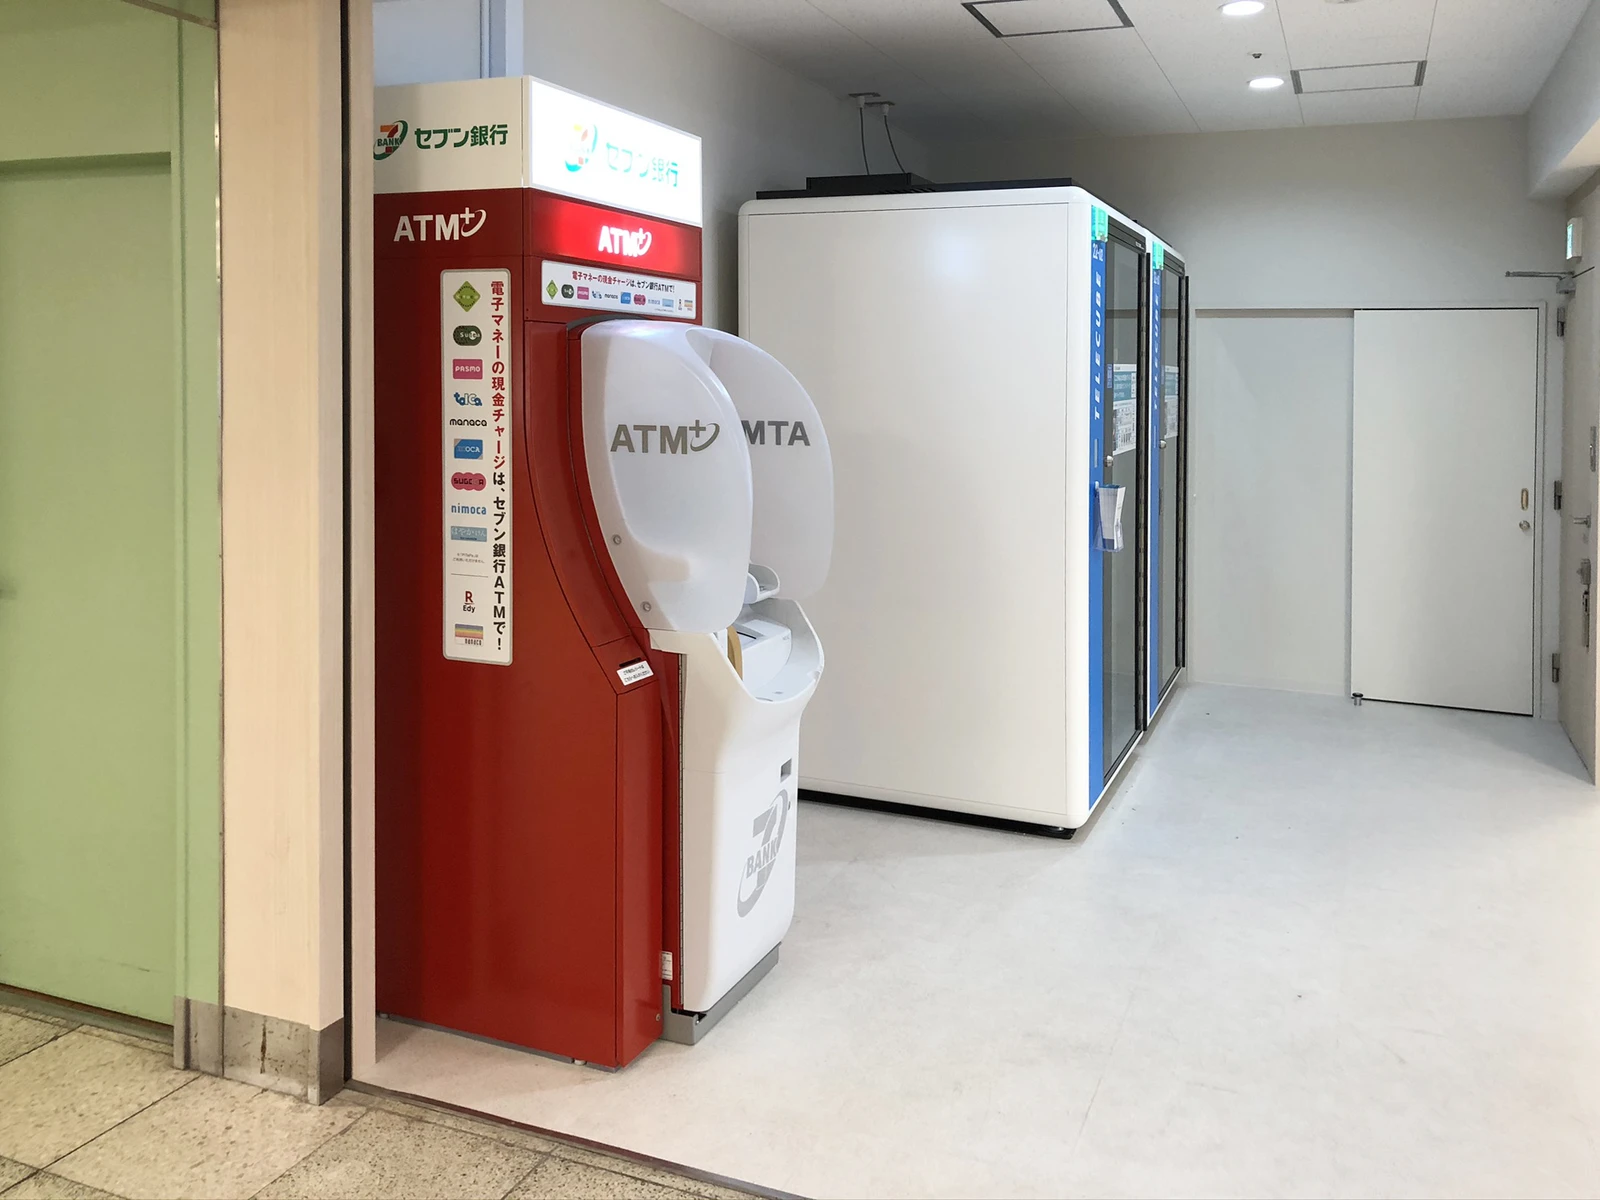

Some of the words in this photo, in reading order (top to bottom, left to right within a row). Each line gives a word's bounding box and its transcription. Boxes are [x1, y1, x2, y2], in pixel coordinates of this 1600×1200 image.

[377, 137, 401, 147] BANK
[414, 123, 509, 150] セブン銀行
[606, 142, 679, 188] セブン銀行
[1093, 271, 1102, 421] TELECUBE
[455, 365, 480, 373] PASMO
[449, 418, 487, 427] manaca
[491, 281, 506, 650] 電子マネーの現金チャージは、セブン銀行ATMで!
[451, 503, 487, 515] nimoca
[465, 591, 473, 603] R
[462, 604, 476, 614] Edy
[746, 840, 780, 880] BANK
